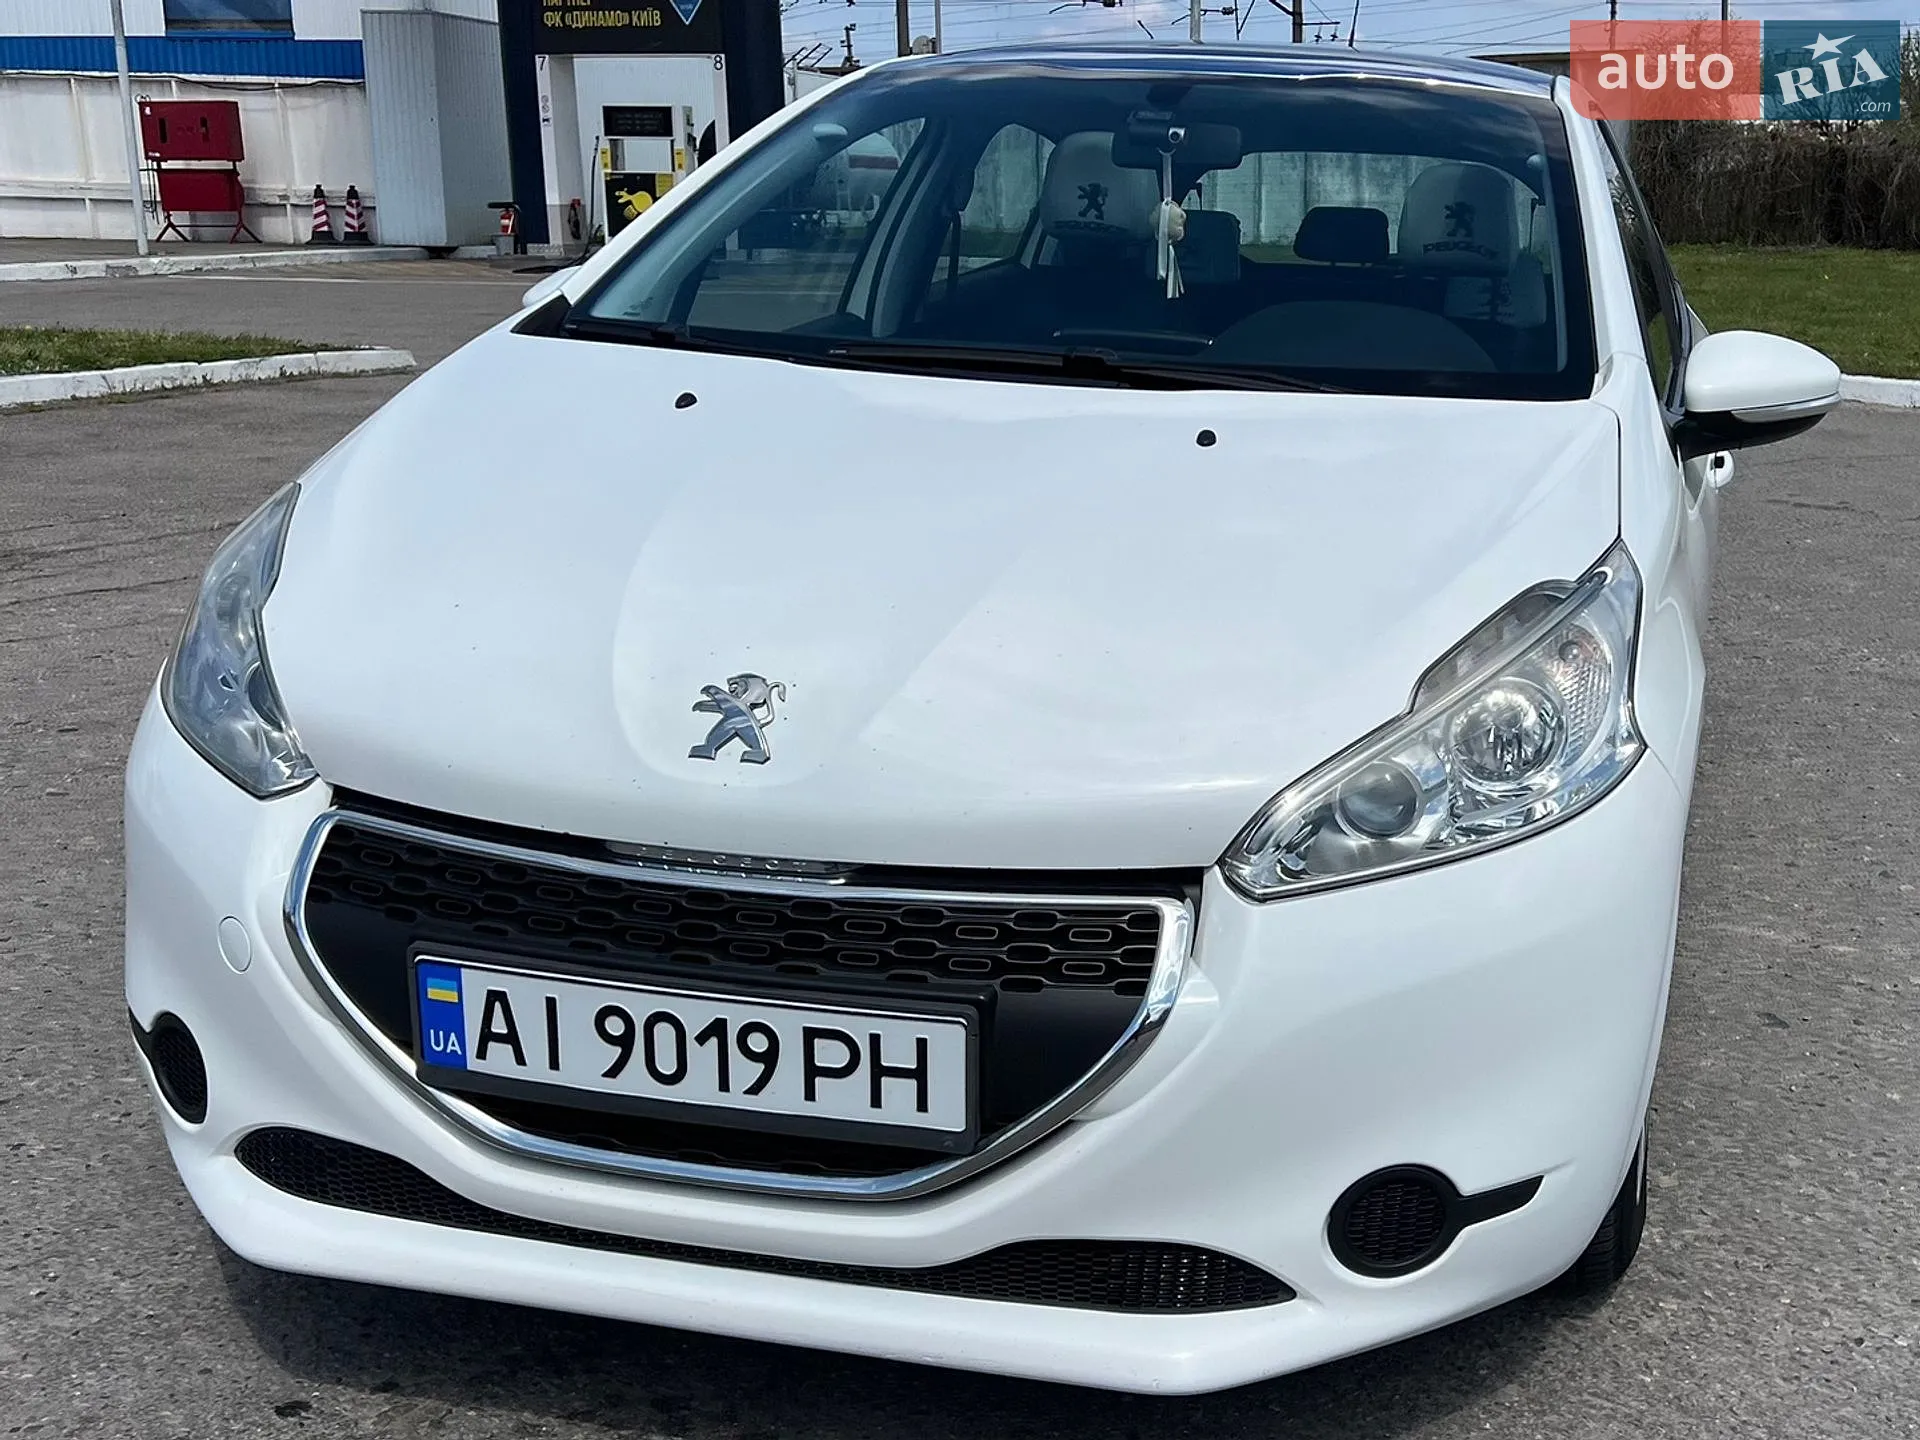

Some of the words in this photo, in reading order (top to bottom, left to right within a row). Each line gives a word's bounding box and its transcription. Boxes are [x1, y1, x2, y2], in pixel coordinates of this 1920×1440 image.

[543, 11, 563, 27] ФК
[565, 10, 629, 28] «ДИНАМО»
[632, 7, 662, 26] КИЇВ
[537, 56, 547, 71] 7
[713, 55, 723, 71] 8
[430, 1031, 462, 1056] UA
[475, 989, 560, 1071] AI
[593, 1004, 780, 1096] 9019
[802, 1025, 929, 1114] PH
